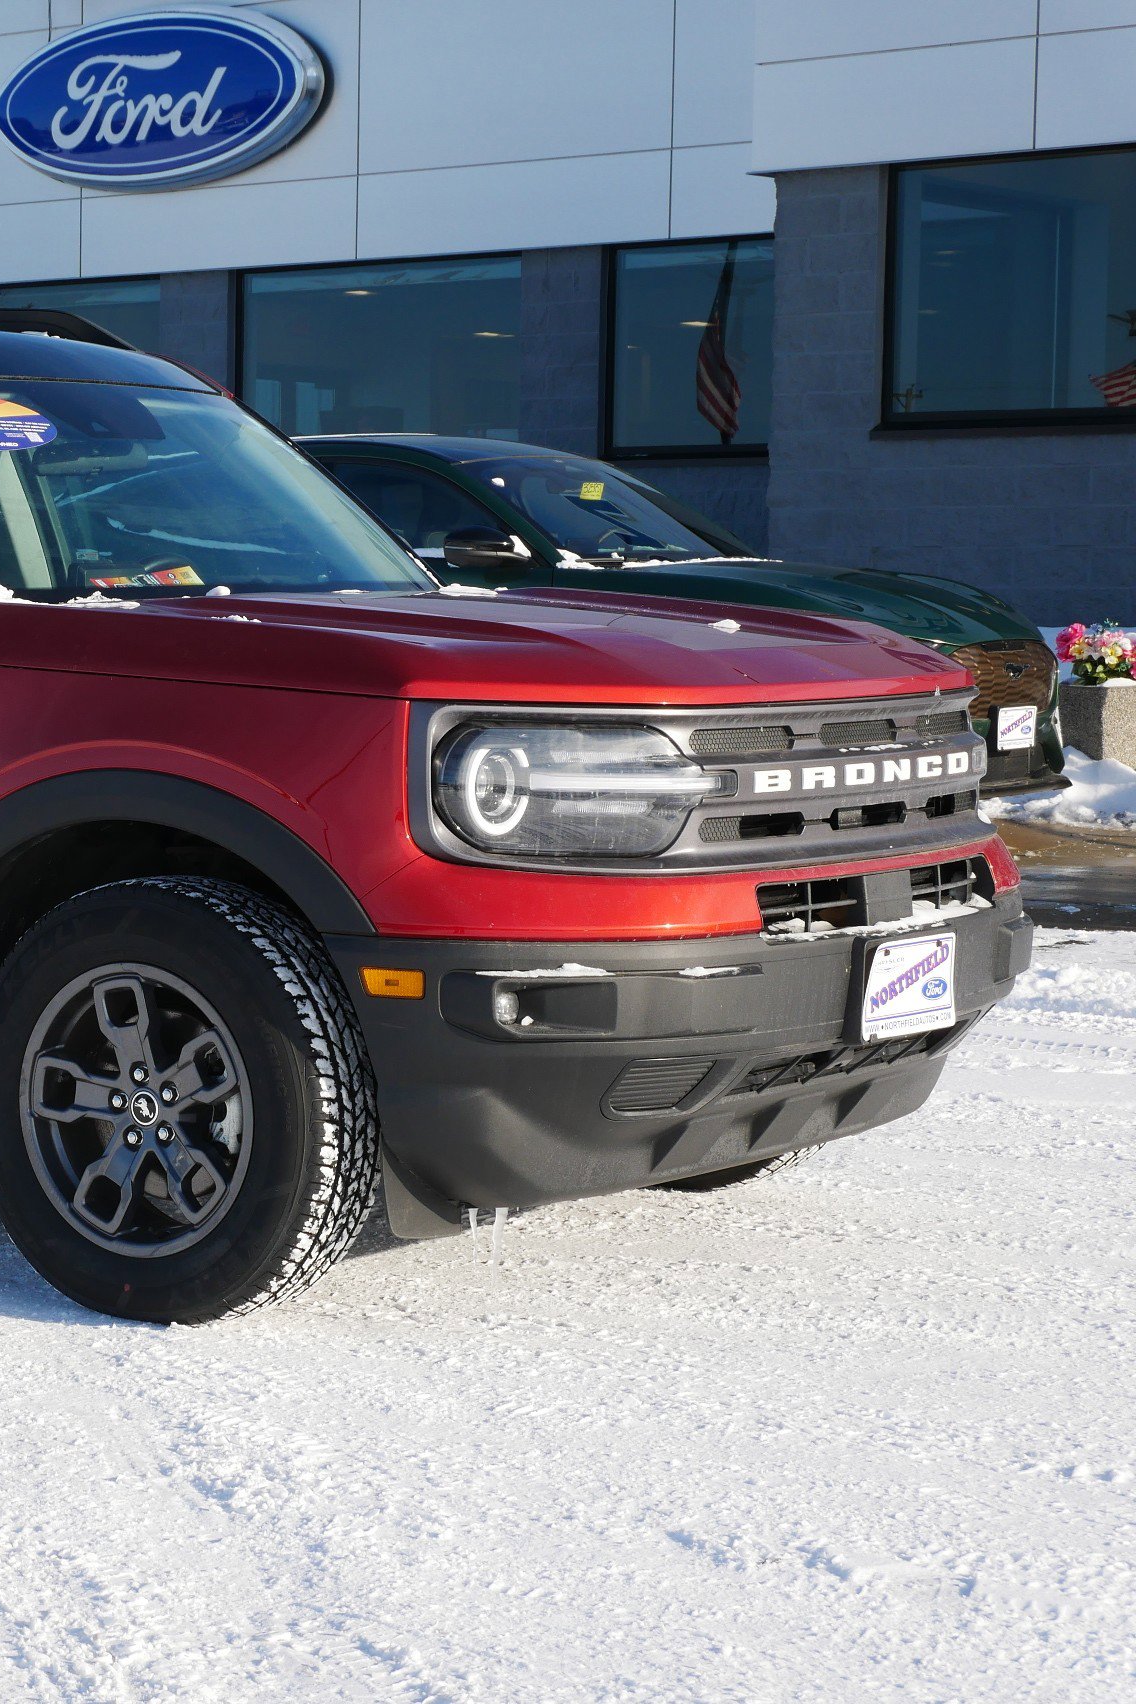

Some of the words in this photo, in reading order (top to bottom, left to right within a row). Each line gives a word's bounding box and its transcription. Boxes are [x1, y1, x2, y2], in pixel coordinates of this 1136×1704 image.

[52, 50, 226, 149] Ford
[1000, 711, 1033, 738] NORTHFIELD
[753, 751, 969, 793] BRONCO
[870, 943, 950, 1013] NORTHFIELD
[925, 981, 944, 996] Ford
